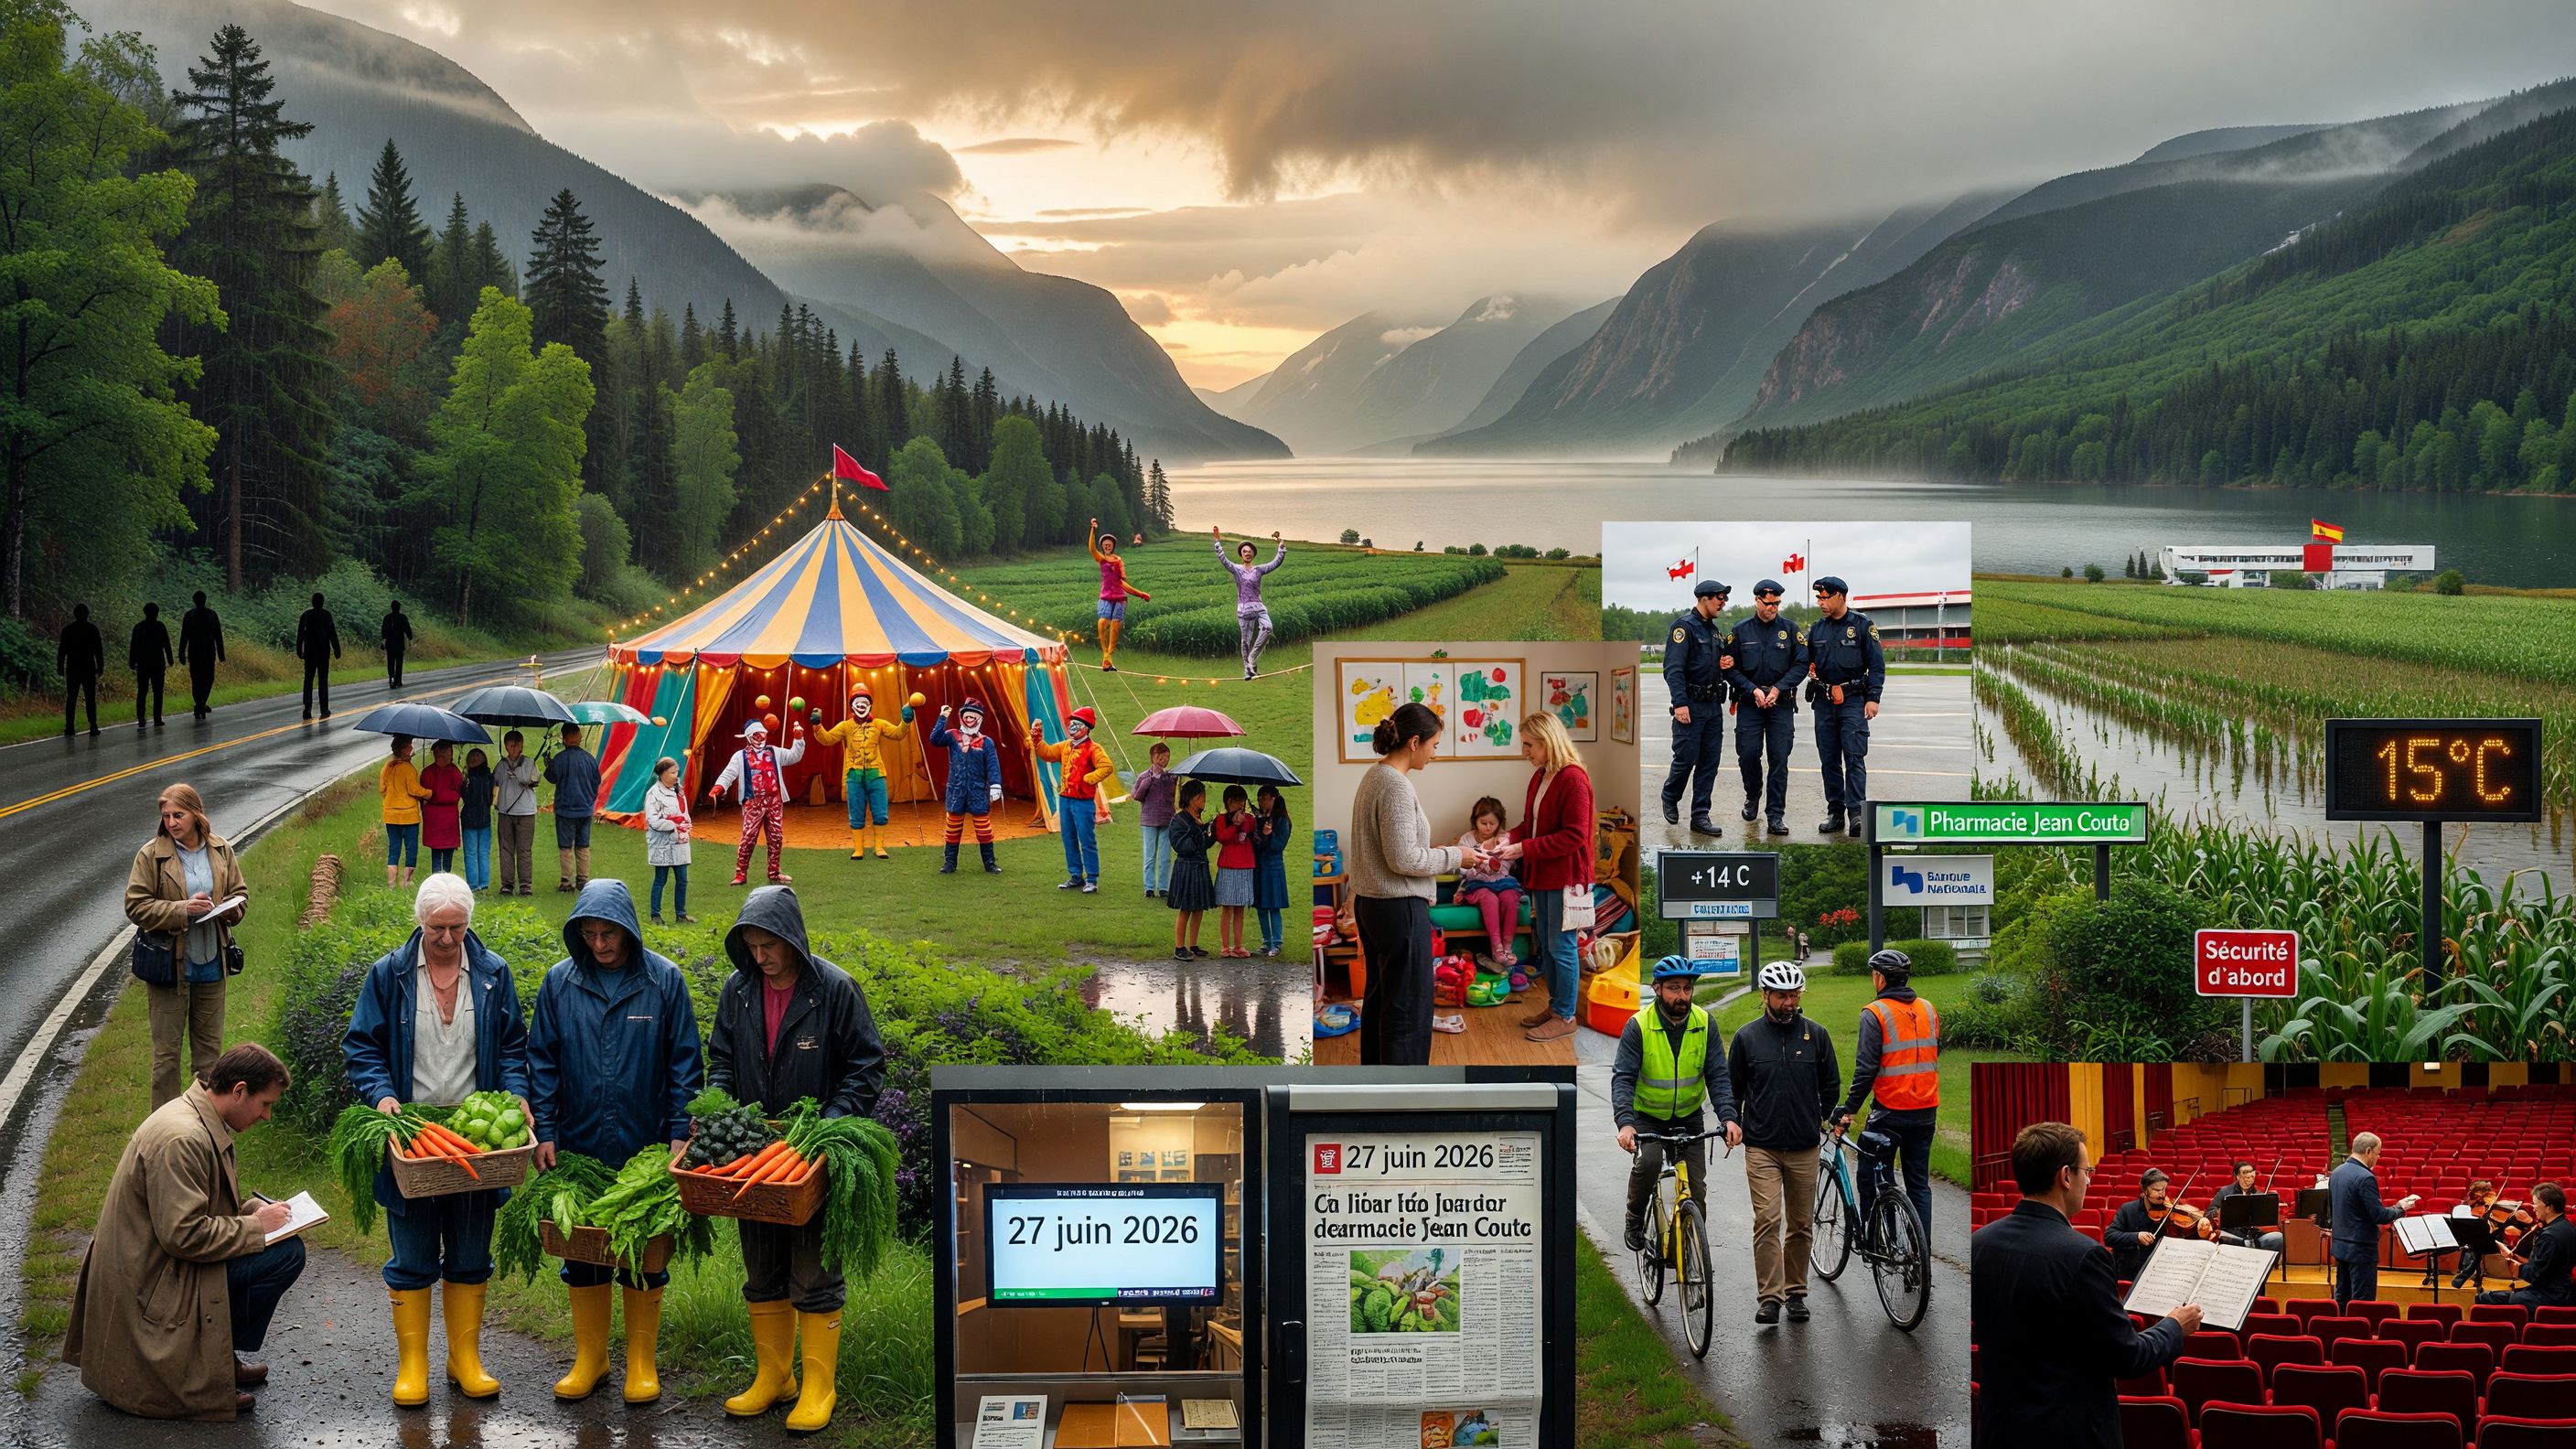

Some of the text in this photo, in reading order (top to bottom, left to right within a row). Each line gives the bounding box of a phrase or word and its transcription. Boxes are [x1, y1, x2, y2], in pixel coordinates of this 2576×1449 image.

[2378, 739, 2510, 800] 15°C
[1930, 810, 2027, 832] Pharmacie
[2031, 811, 2073, 835] Jean
[1737, 865, 1750, 886] C
[2206, 939, 2288, 961] Sécurité
[2208, 966, 2285, 987] d'abord
[1347, 1144, 1376, 1168] 27
[1380, 1144, 1426, 1175] juin
[1434, 1144, 1494, 1168] 2026
[1008, 1216, 1198, 1251] 27 juin 2026
